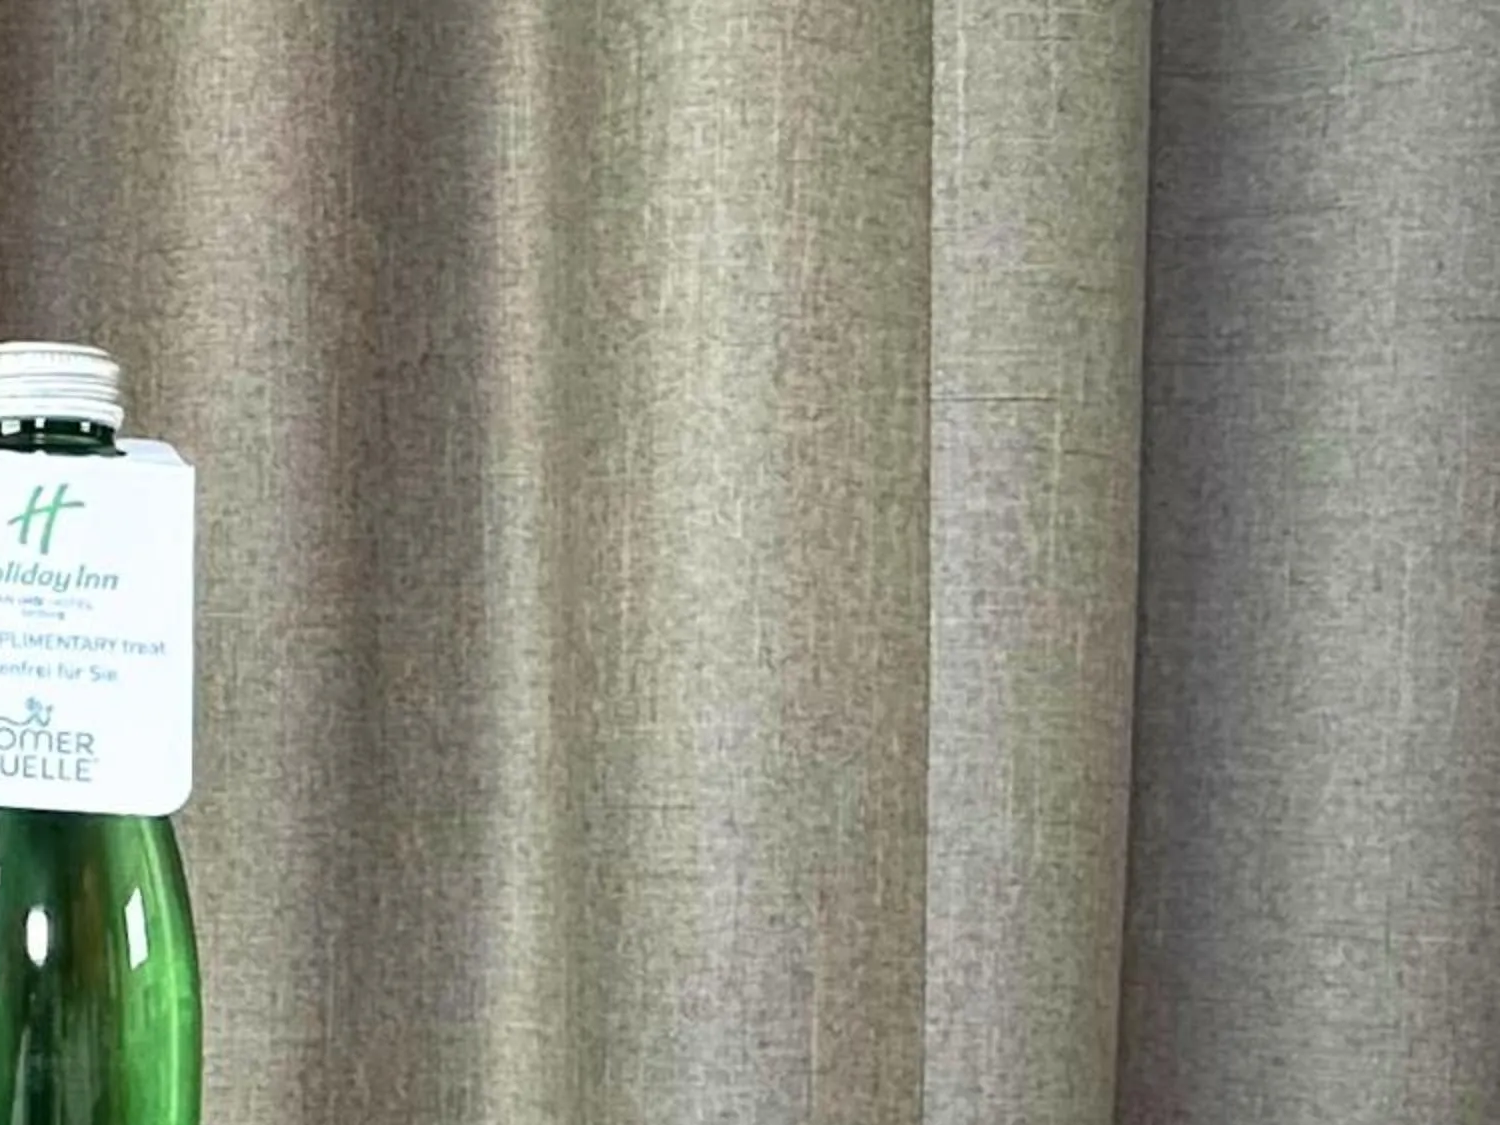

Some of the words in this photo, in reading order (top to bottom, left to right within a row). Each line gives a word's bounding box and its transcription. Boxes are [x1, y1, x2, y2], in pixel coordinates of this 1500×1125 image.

[75, 564, 120, 590] Inn
[122, 639, 166, 655] treat
[89, 665, 118, 683] Sie
